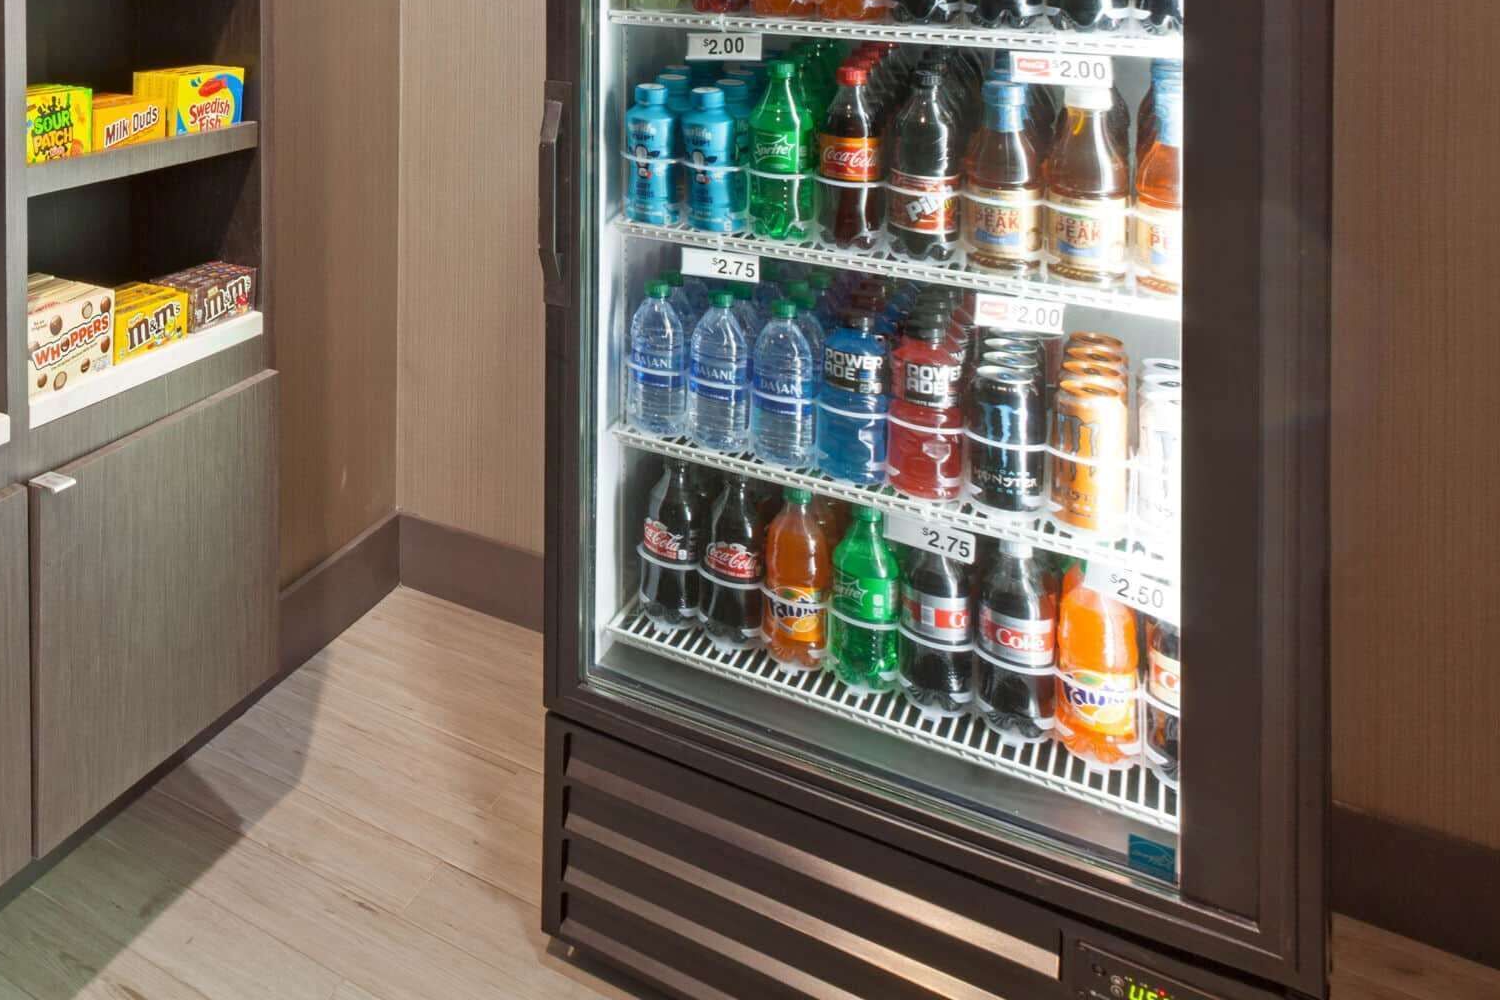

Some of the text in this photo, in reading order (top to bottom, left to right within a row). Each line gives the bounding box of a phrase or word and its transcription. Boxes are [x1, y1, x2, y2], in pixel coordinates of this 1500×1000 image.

[703, 37, 744, 55] $2.00
[34, 110, 72, 135] SOUR
[189, 98, 230, 124] Swedish
[105, 106, 158, 146] Milk Duds
[198, 114, 222, 133] Fish
[33, 128, 73, 152] PATCH
[975, 212, 1020, 230] PEAK
[713, 257, 756, 279] $2.75
[34, 313, 109, 366] WHOPPERS
[825, 348, 883, 369] POWER
[825, 363, 856, 380] ADE
[907, 363, 962, 383] POWER
[907, 377, 948, 394] ADE
[923, 526, 971, 558] $2.75
[1110, 573, 1165, 608] $2.50
[996, 627, 1045, 651] Coke
